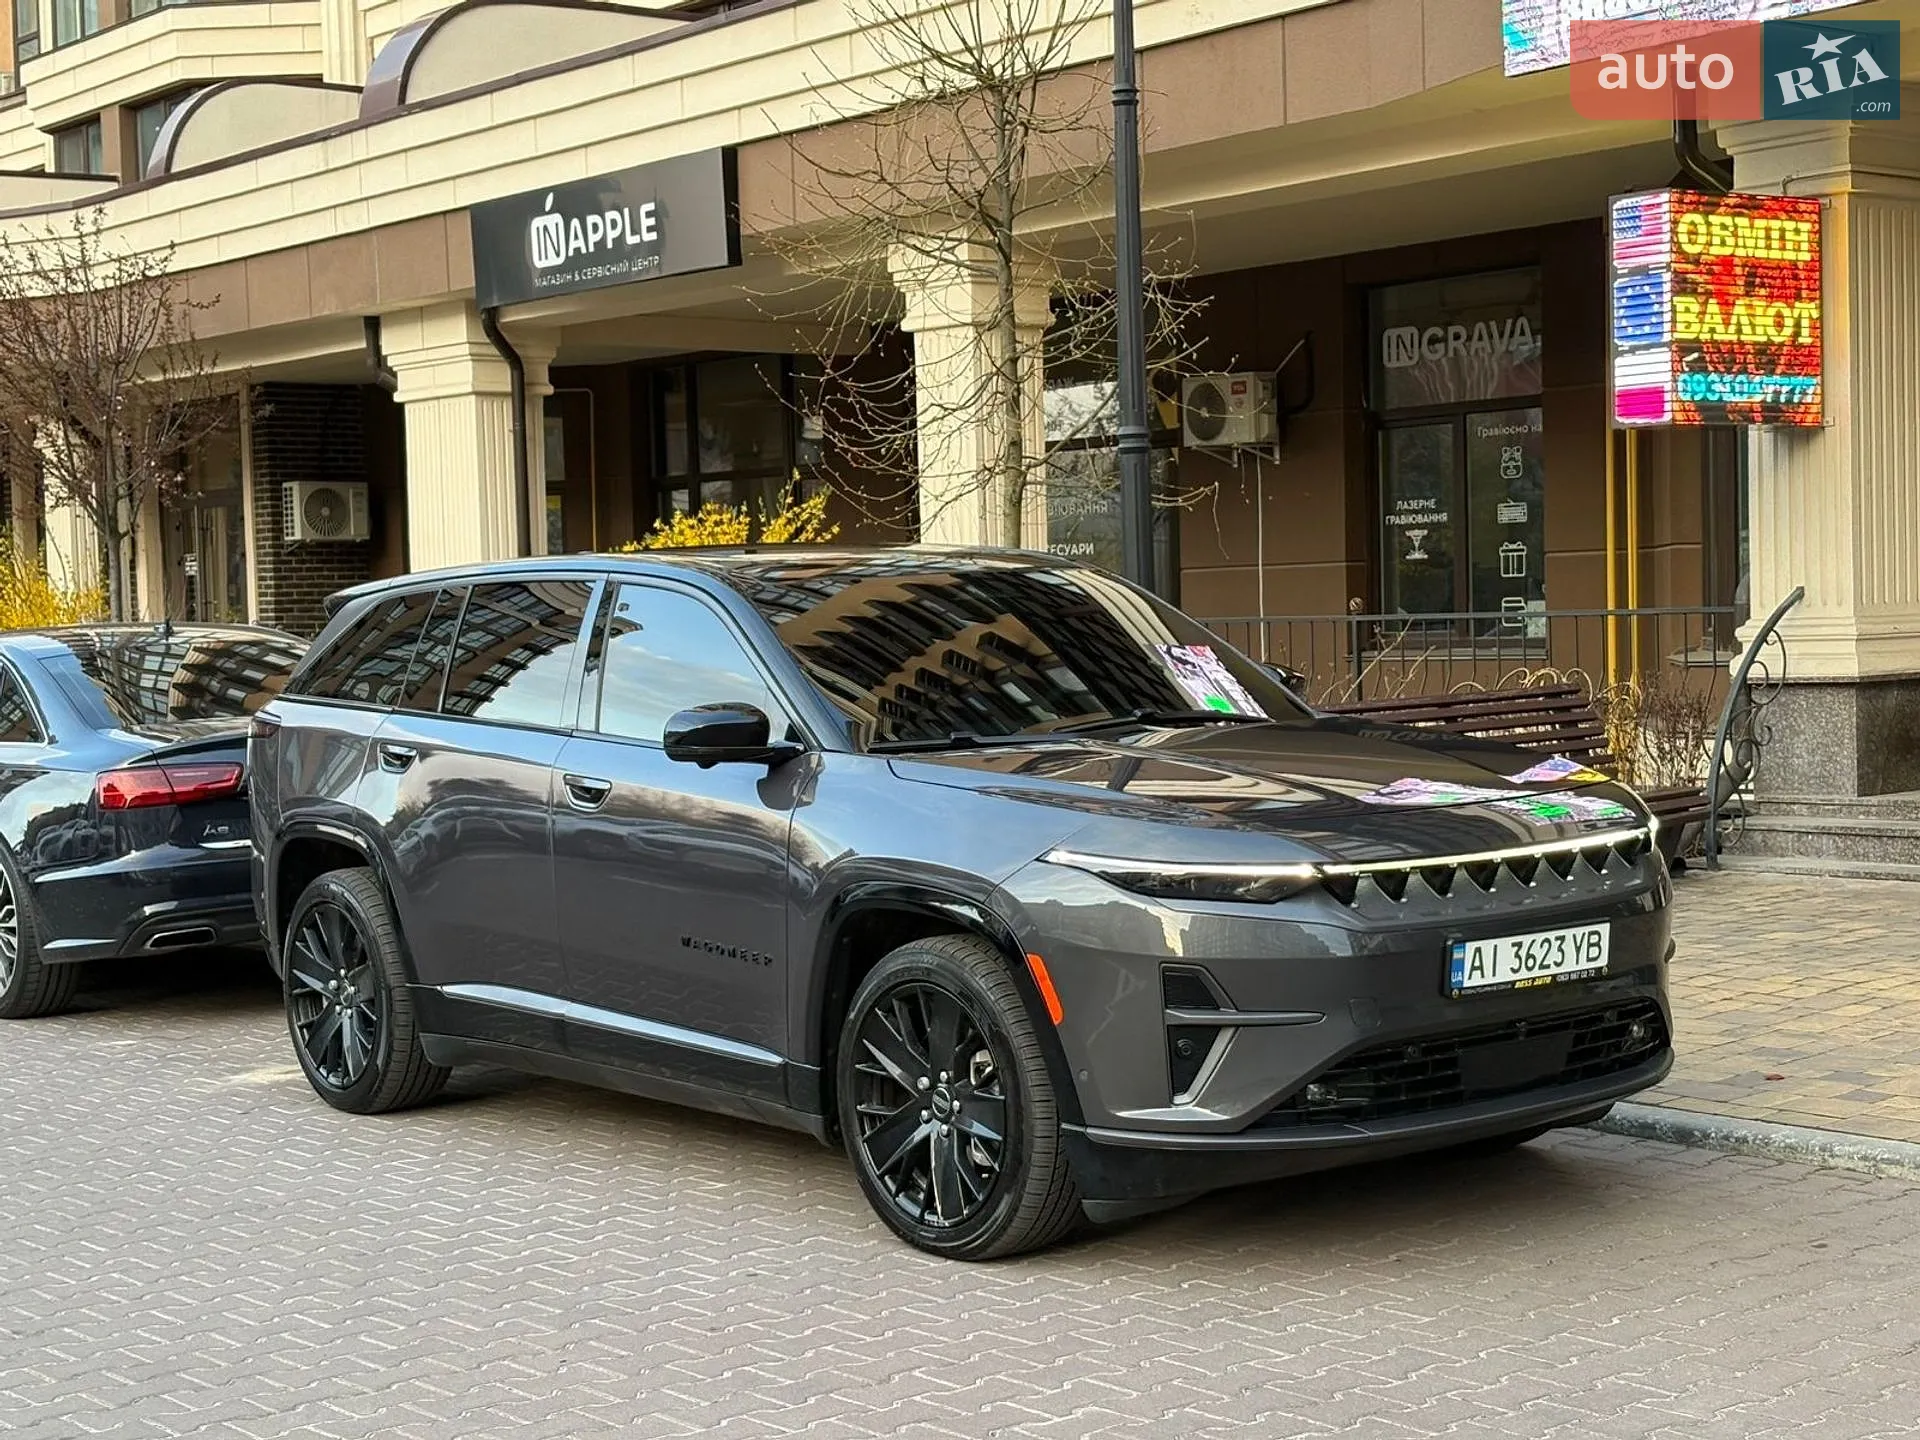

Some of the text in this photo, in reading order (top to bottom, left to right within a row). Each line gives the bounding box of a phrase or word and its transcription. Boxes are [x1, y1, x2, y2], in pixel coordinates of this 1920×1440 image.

[1677, 212, 1812, 262] ОБМІН
[535, 272, 573, 287] МАГАЗИН
[582, 260, 629, 279] СЕРВІСНИЙ
[631, 255, 660, 272] ЦЕНТР
[1673, 296, 1819, 343] ВАЛЮТ
[1385, 512, 1448, 526] ГРАВІЮВАННЯ
[1396, 499, 1437, 511] ЛАЗЕРНЕ
[1468, 929, 1602, 981] AI 3623 YB
[1451, 971, 1464, 983] UA
